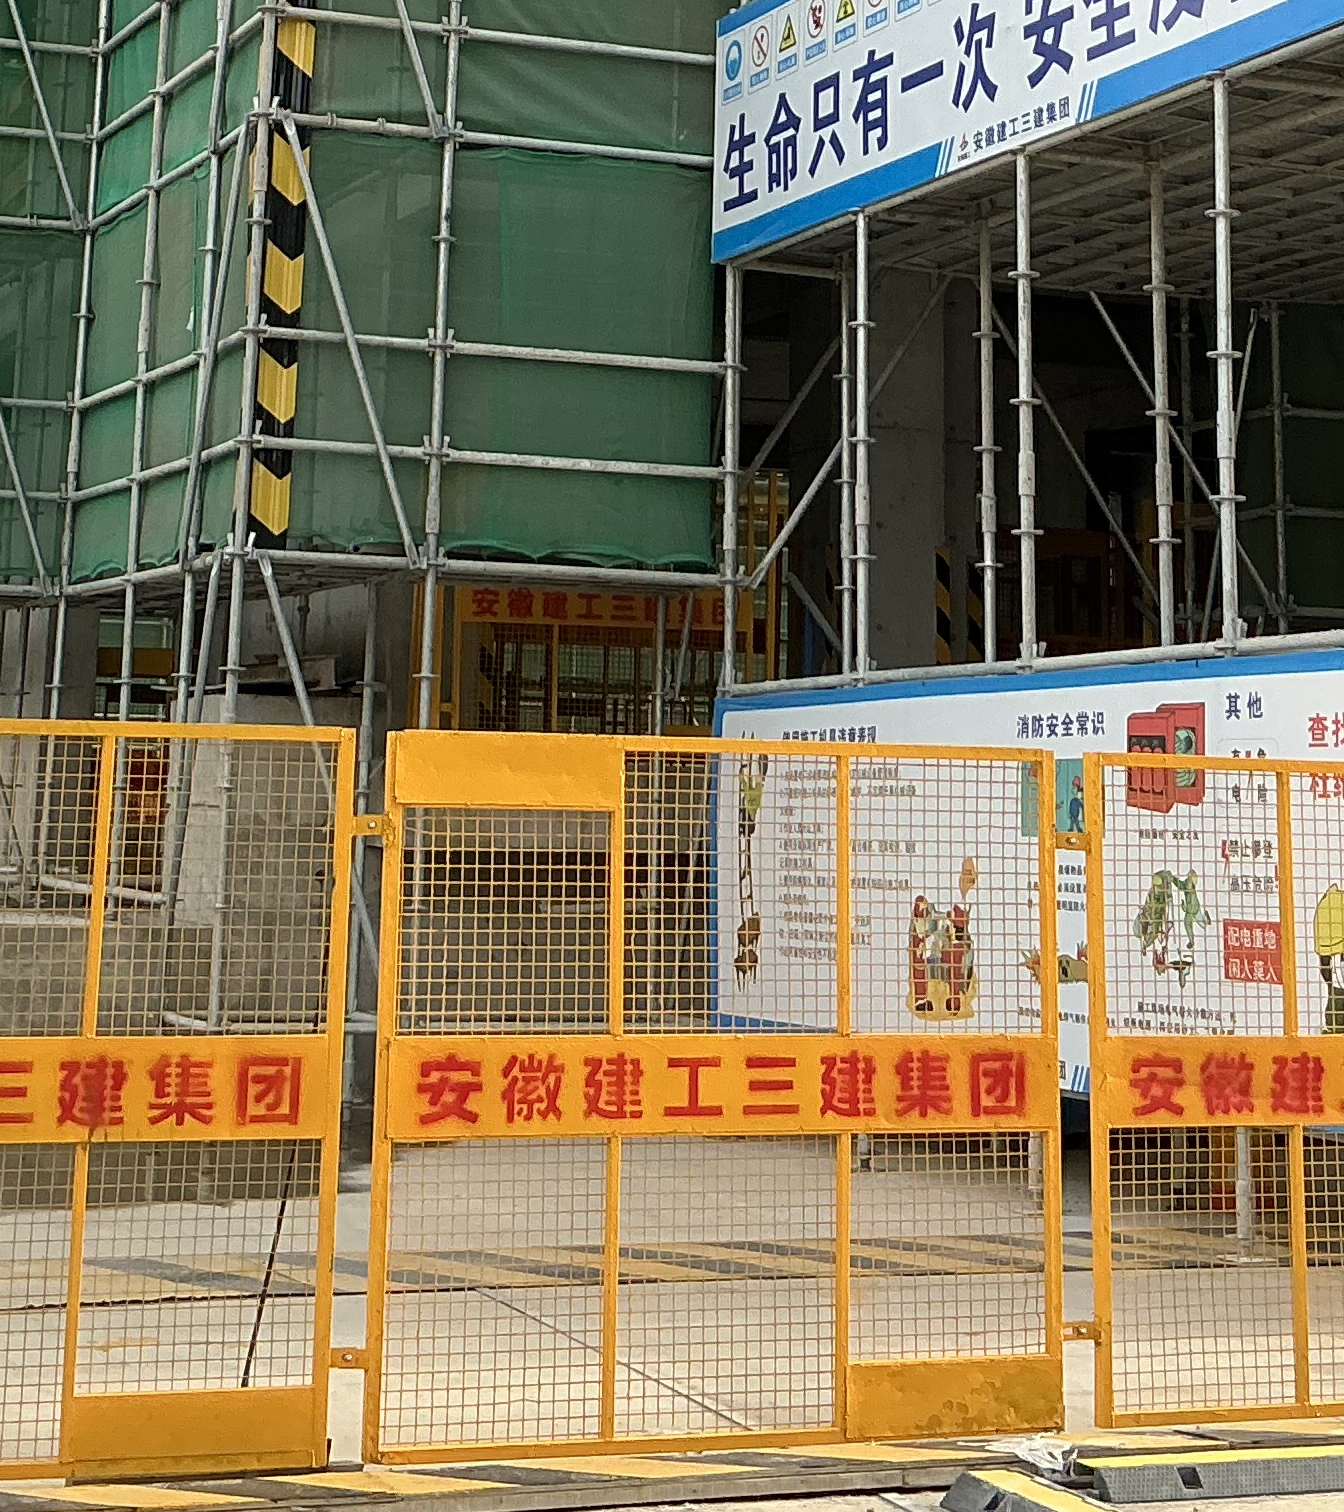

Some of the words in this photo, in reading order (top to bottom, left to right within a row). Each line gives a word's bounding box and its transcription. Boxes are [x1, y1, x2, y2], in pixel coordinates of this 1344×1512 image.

[722, 2, 998, 213] 生命只有一次
[972, 96, 1071, 153] 安徽建工三建集团
[1016, 710, 1106, 740] 消防安全常识
[416, 1049, 1027, 1127] 安徽建工三建集团
